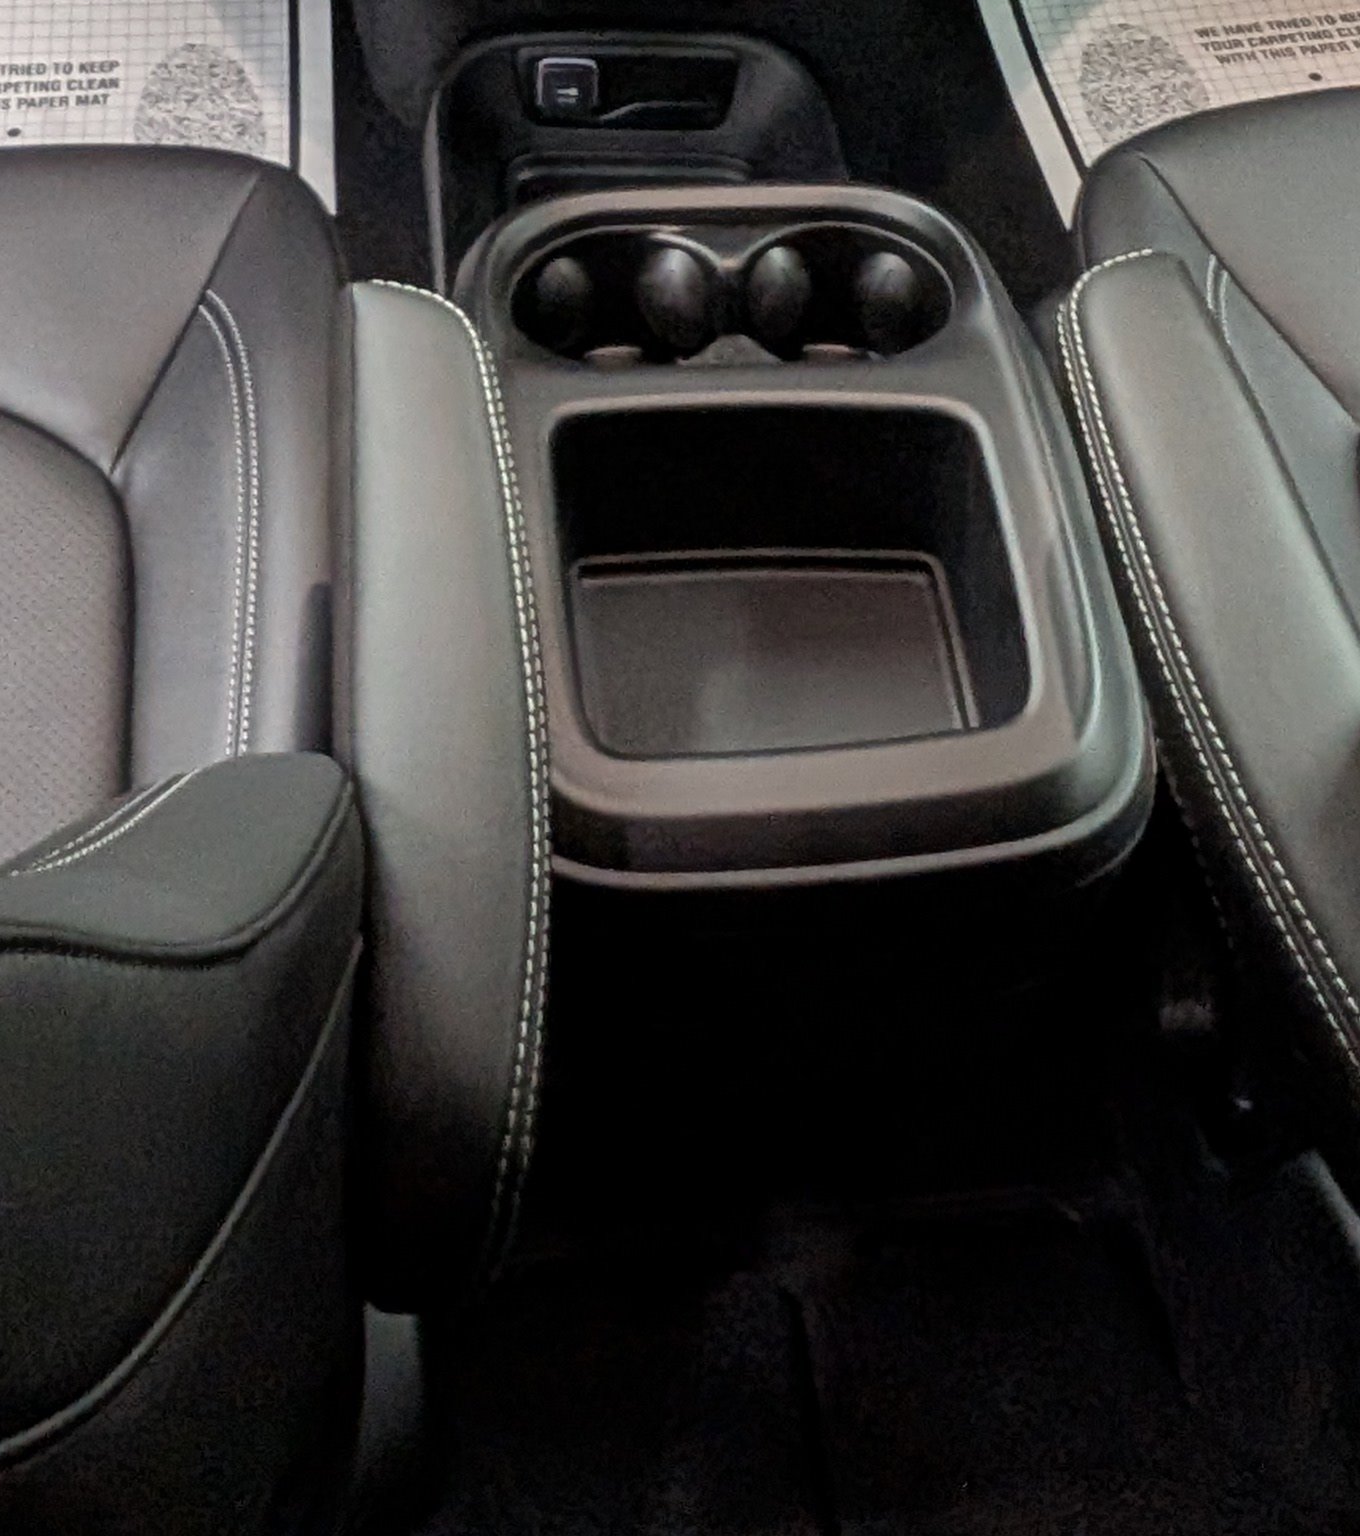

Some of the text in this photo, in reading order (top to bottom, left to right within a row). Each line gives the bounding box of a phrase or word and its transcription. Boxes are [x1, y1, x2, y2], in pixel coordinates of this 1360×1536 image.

[1193, 26, 1221, 39] WE
[1222, 21, 1264, 36] HAVE
[1266, 16, 1313, 31] TRIED
[1315, 14, 1338, 26] TO
[1200, 38, 1245, 52] YOUR
[1247, 29, 1334, 48] CARPETING
[1213, 50, 1260, 65] WITH
[1260, 46, 1297, 60] THIS
[1298, 40, 1352, 56] PAPER
[0, 62, 47, 76] TRIED
[53, 61, 74, 75] TO
[78, 60, 120, 74] KEEP
[66, 77, 120, 92] CLEAN
[16, 95, 69, 109] PAPER
[75, 93, 110, 107] MAT
